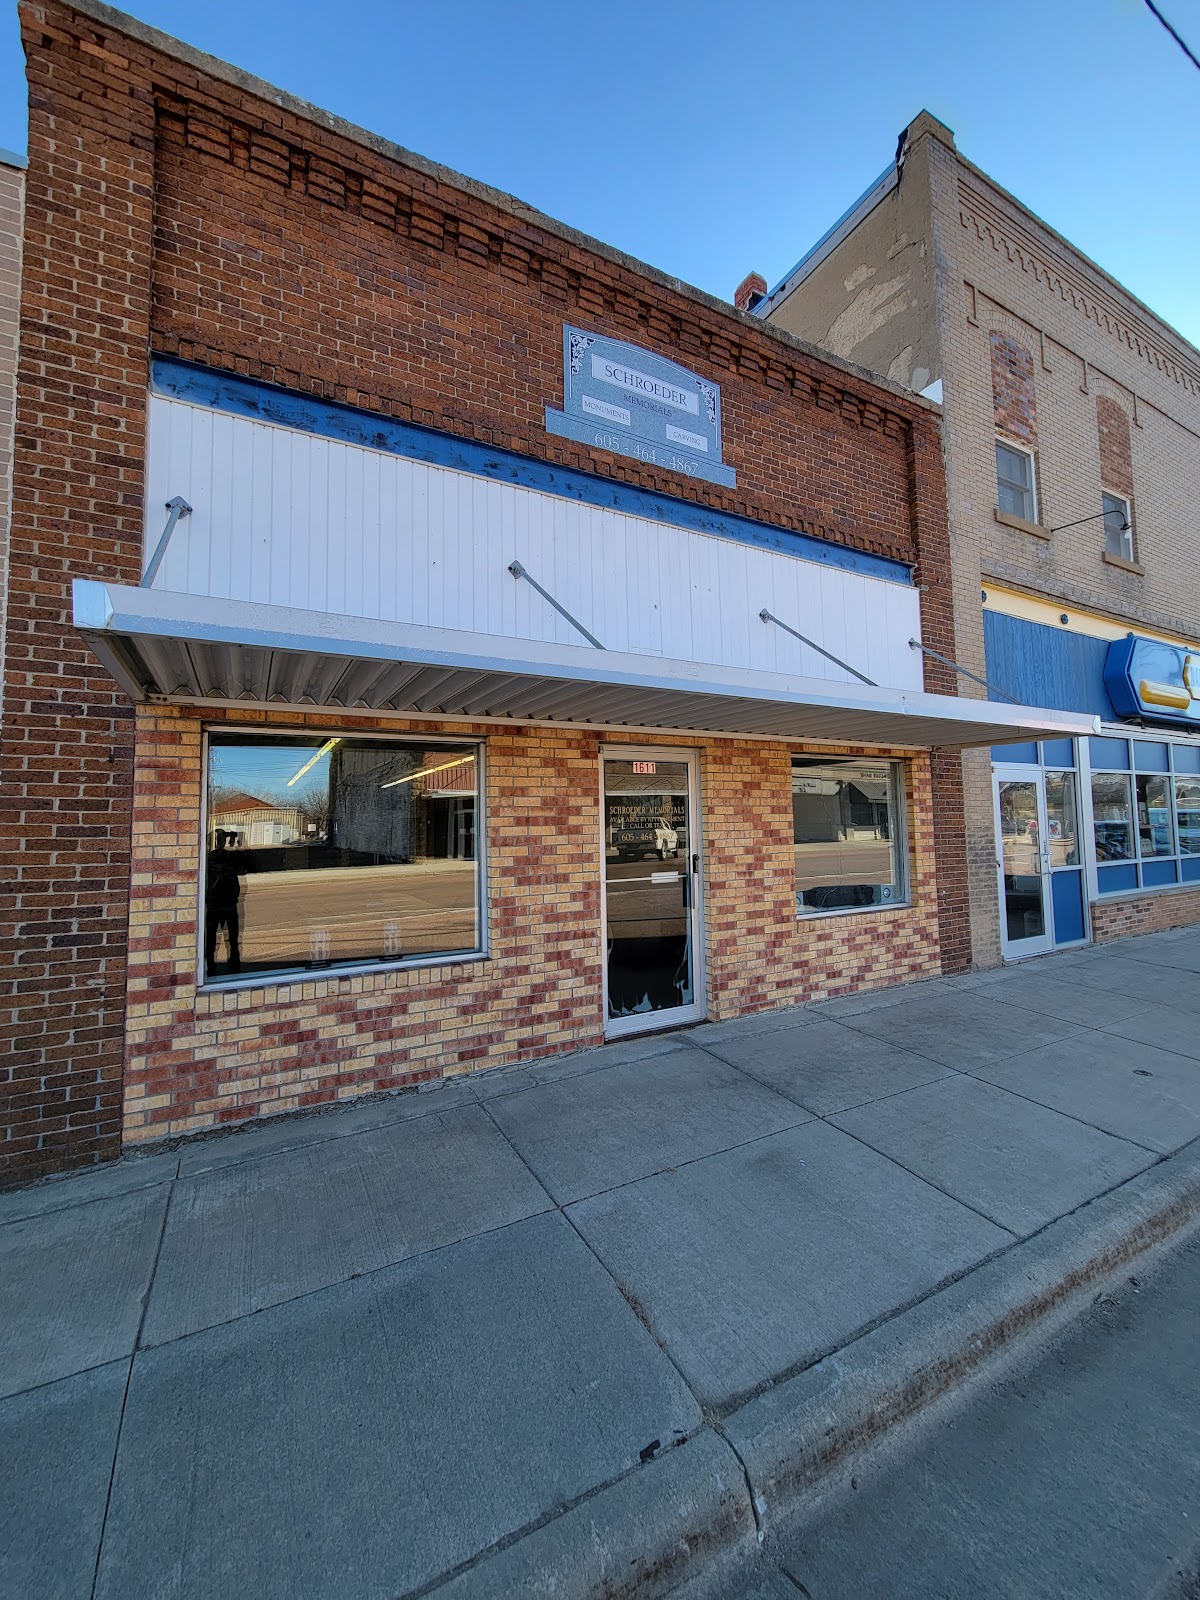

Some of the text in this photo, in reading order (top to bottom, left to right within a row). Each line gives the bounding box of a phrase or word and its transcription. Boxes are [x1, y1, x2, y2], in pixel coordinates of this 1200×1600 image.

[605, 364, 687, 407] SCHROEDER
[584, 400, 629, 420] MONUMENTS
[623, 393, 673, 418] MEMORIALS
[673, 431, 701, 446] CARVING
[594, 432, 620, 451] 605
[633, 444, 657, 462] 464
[669, 456, 699, 475] 4867
[634, 762, 655, 773] 1611
[609, 806, 685, 815] SCHROEDER MEMORIALS
[621, 833, 635, 841] 605
[640, 833, 653, 841] 464
